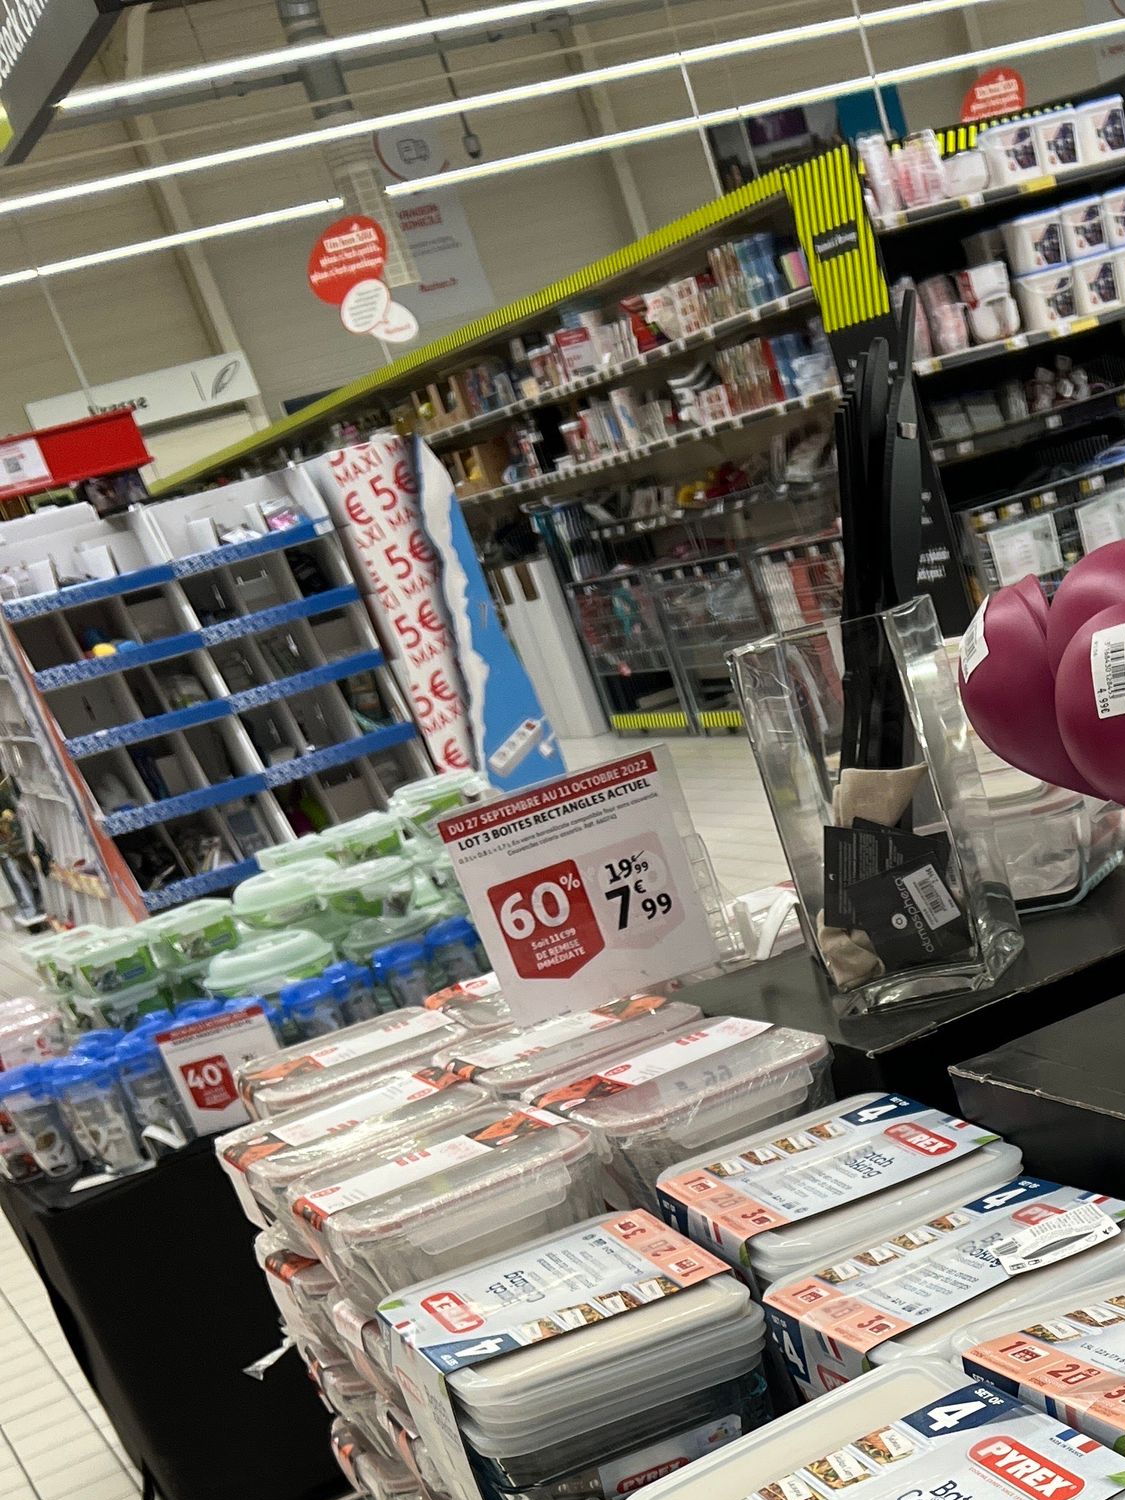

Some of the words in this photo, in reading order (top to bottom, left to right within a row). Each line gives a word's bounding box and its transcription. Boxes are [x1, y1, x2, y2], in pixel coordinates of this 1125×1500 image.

[448, 822, 464, 836] DU
[465, 817, 478, 831] 27
[479, 799, 541, 826] SEPTEMBRE
[542, 791, 557, 805] AU
[557, 788, 571, 801] 11
[571, 772, 620, 795] OCTOBRE
[621, 760, 648, 778] 2022
[458, 835, 481, 852] LOT
[482, 831, 492, 844] 3
[492, 819, 533, 840] BOITES
[534, 793, 607, 826] RECTANGLES
[606, 778, 650, 801] ACTUEL
[536, 948, 549, 960] DE
[549, 939, 580, 957] REMISE
[857, 1105, 897, 1124] 4
[927, 1400, 986, 1431] 4
[977, 1441, 1072, 1498] PYREX
